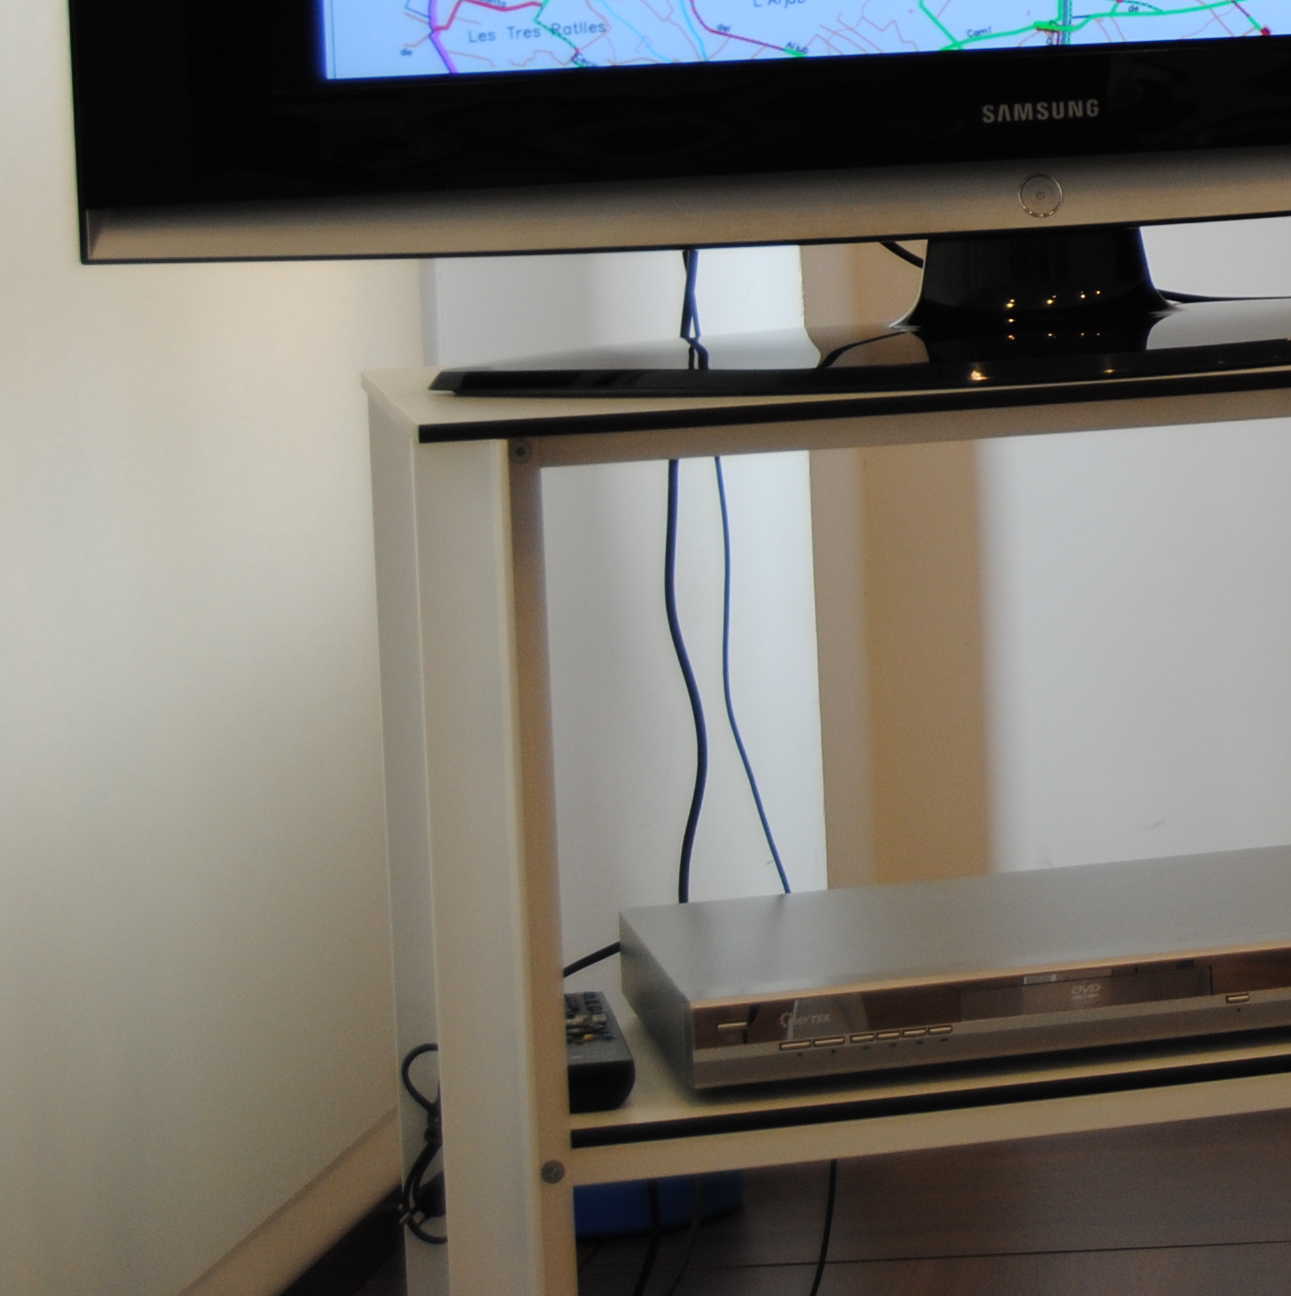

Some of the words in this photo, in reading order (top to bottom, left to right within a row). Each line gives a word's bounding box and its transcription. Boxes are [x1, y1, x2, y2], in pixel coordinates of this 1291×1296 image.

[468, 30, 497, 44] Les
[506, 26, 541, 39] Tres
[981, 98, 1101, 124] SAMSUNG
